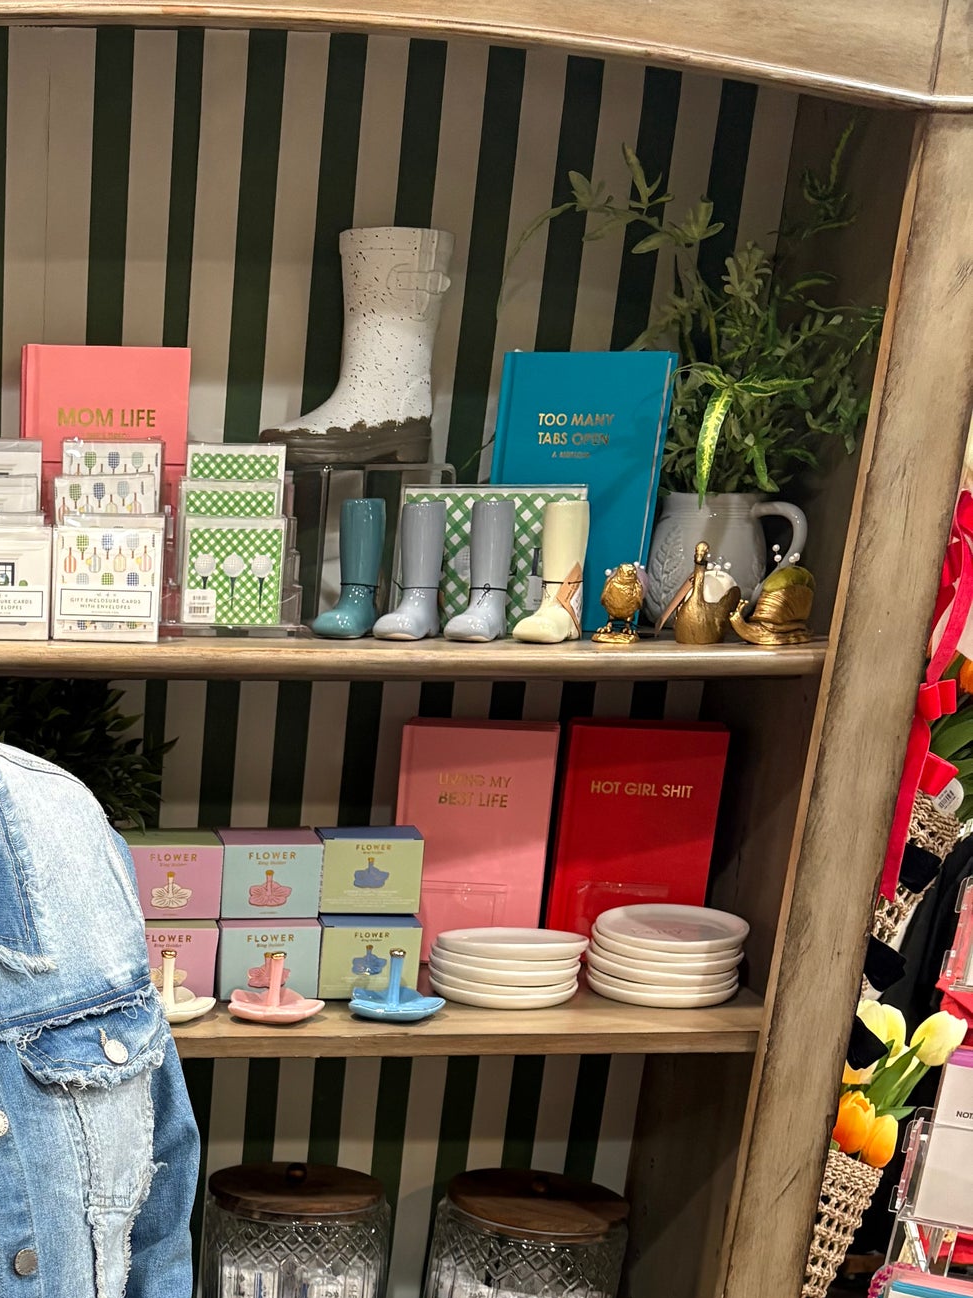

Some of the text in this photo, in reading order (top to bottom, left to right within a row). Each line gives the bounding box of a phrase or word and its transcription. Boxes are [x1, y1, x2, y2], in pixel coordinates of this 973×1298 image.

[57, 407, 156, 428] MOM LIFE
[538, 413, 615, 427] TOO MANY
[538, 432, 610, 446] TABS OPEN
[438, 772, 512, 788] LIVING MY
[590, 780, 694, 799] HOT GIRL SHIT
[438, 791, 508, 808] BEST LIFE
[356, 843, 392, 851] FLOWER
[149, 853, 198, 862] FLOWER
[248, 851, 297, 860] FLOWER
[247, 933, 295, 943] FLOWER
[354, 931, 391, 939] FLOWER
